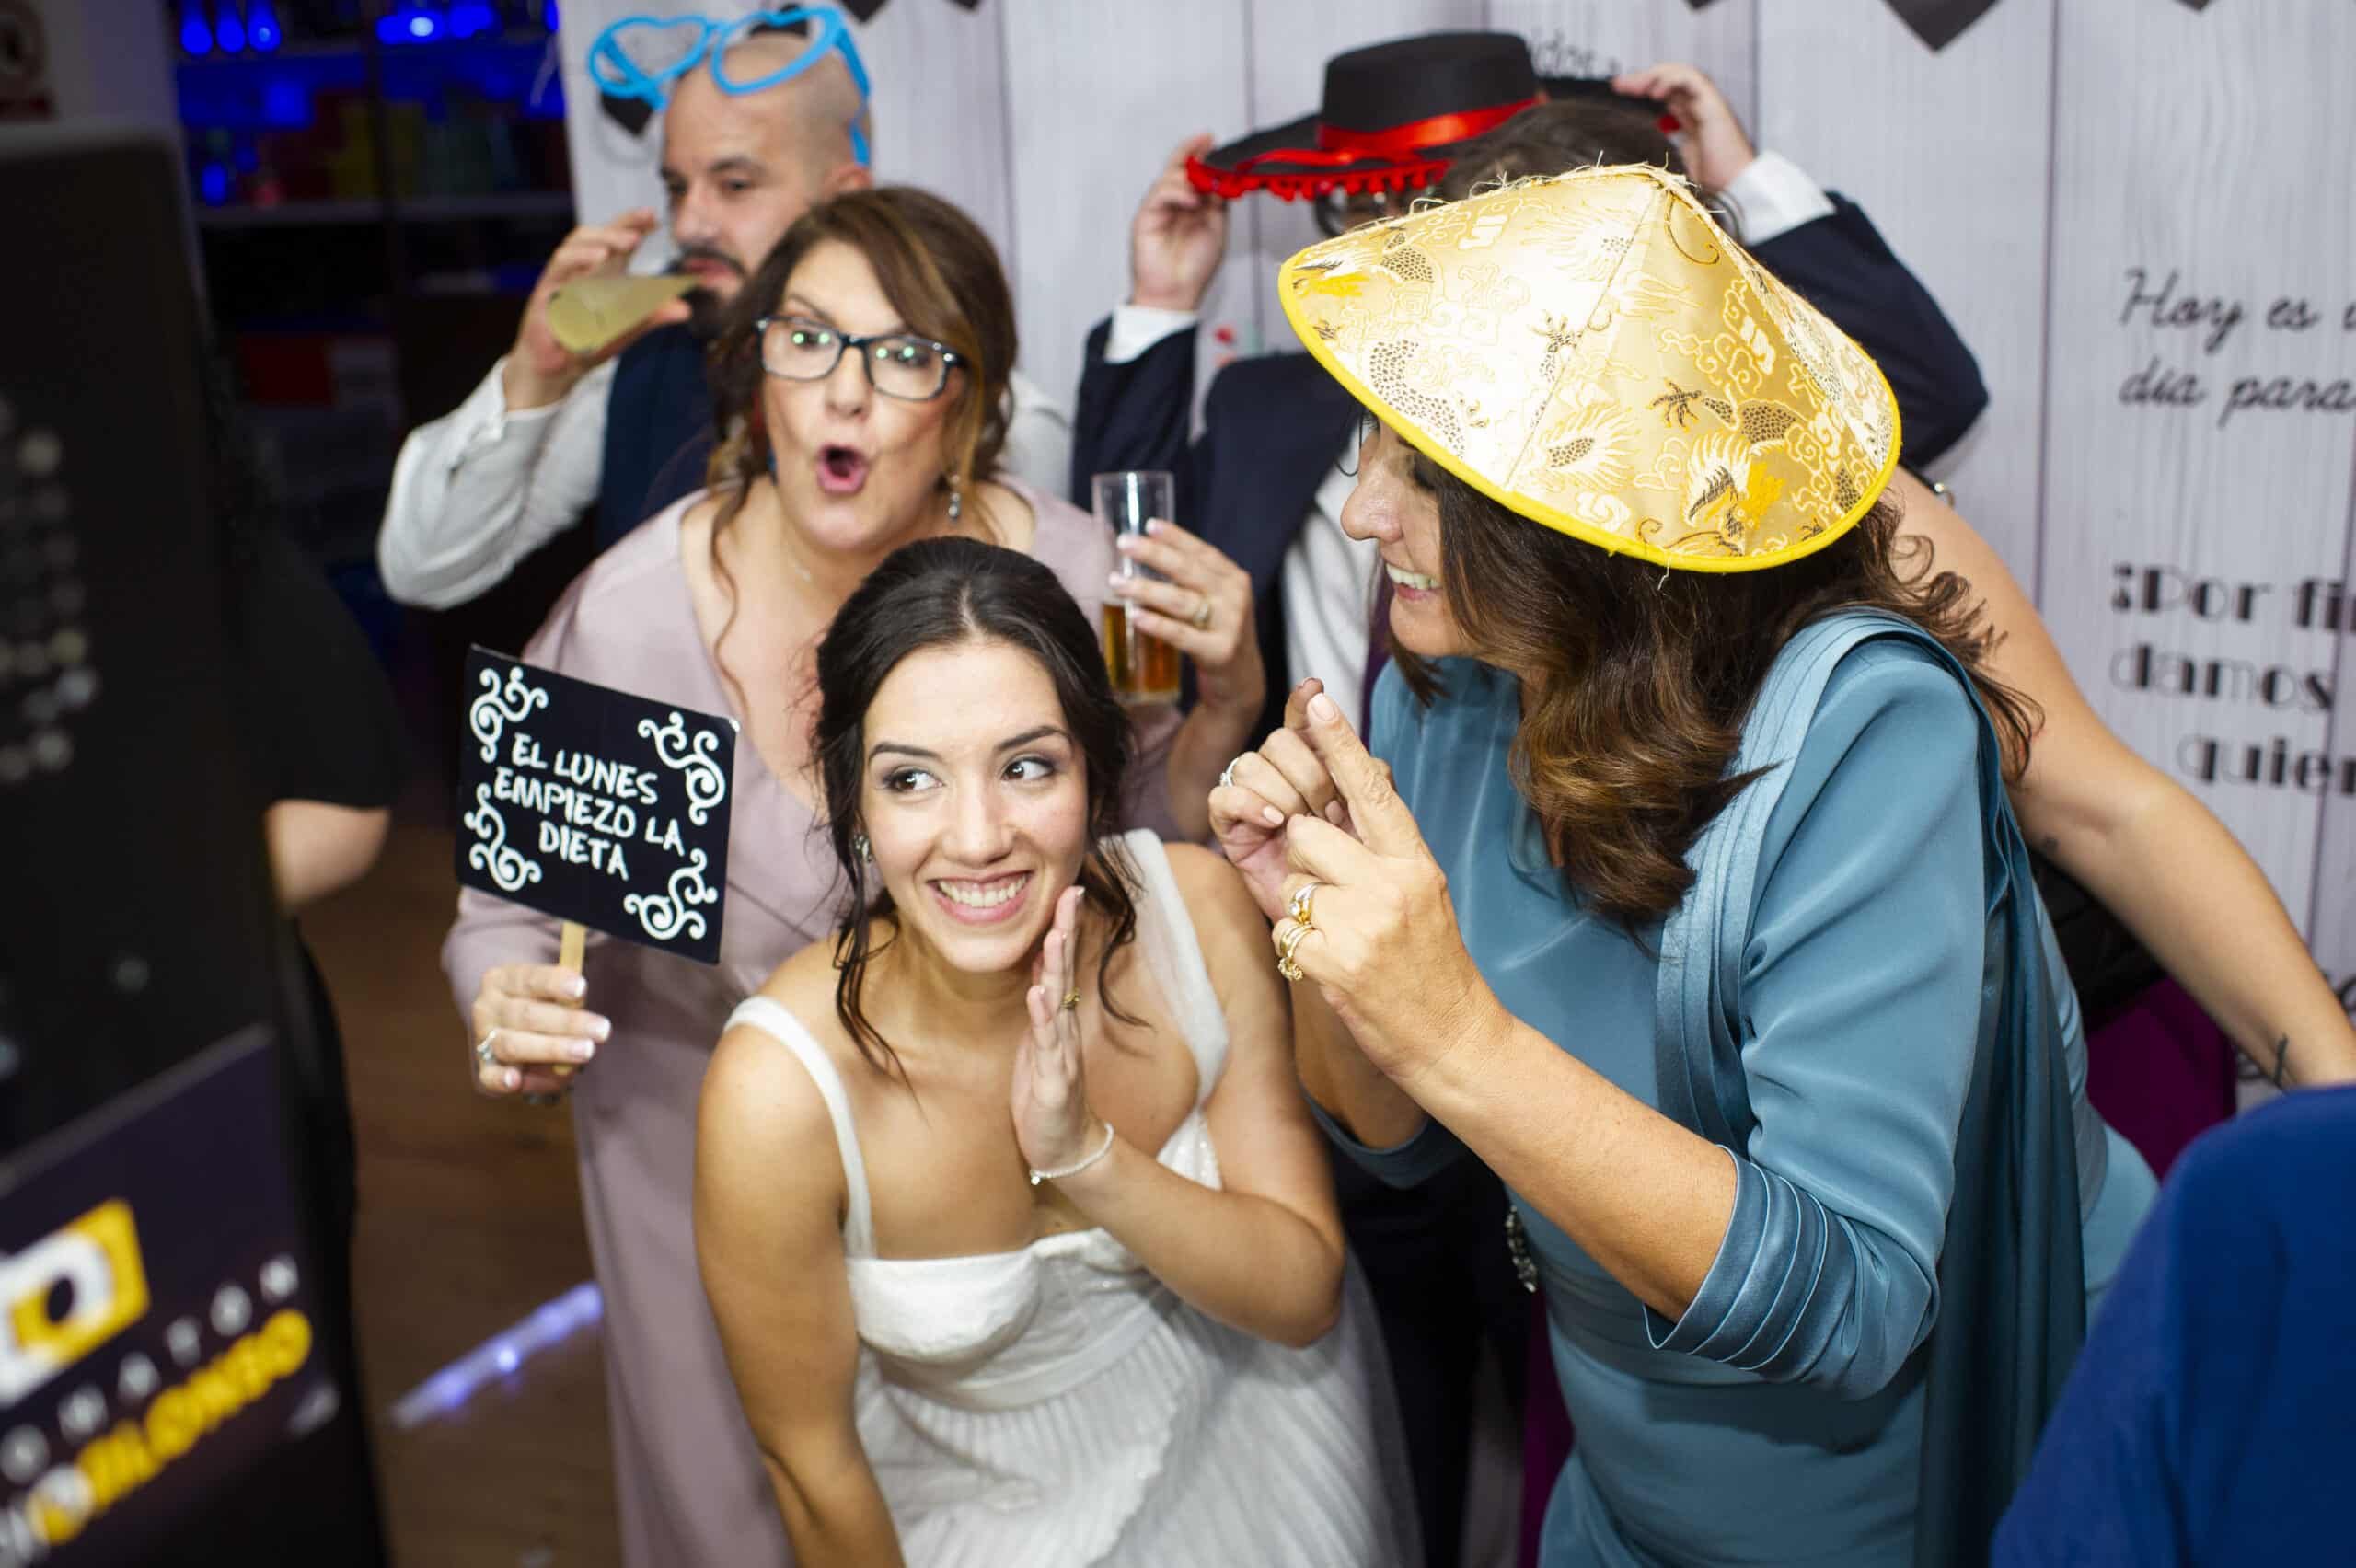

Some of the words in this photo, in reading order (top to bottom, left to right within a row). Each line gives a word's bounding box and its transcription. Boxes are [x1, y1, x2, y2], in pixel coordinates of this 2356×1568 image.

[2119, 268, 2243, 354] Hoy
[2265, 296, 2322, 331] es
[2216, 376, 2356, 430] para
[2295, 576, 2356, 633] fi
[2109, 644, 2332, 713] damos
[511, 732, 549, 770] EL
[554, 750, 659, 805] LUNES
[493, 767, 637, 839] EMPIEZO
[644, 816, 686, 857] LA
[538, 820, 630, 882] DIETA
